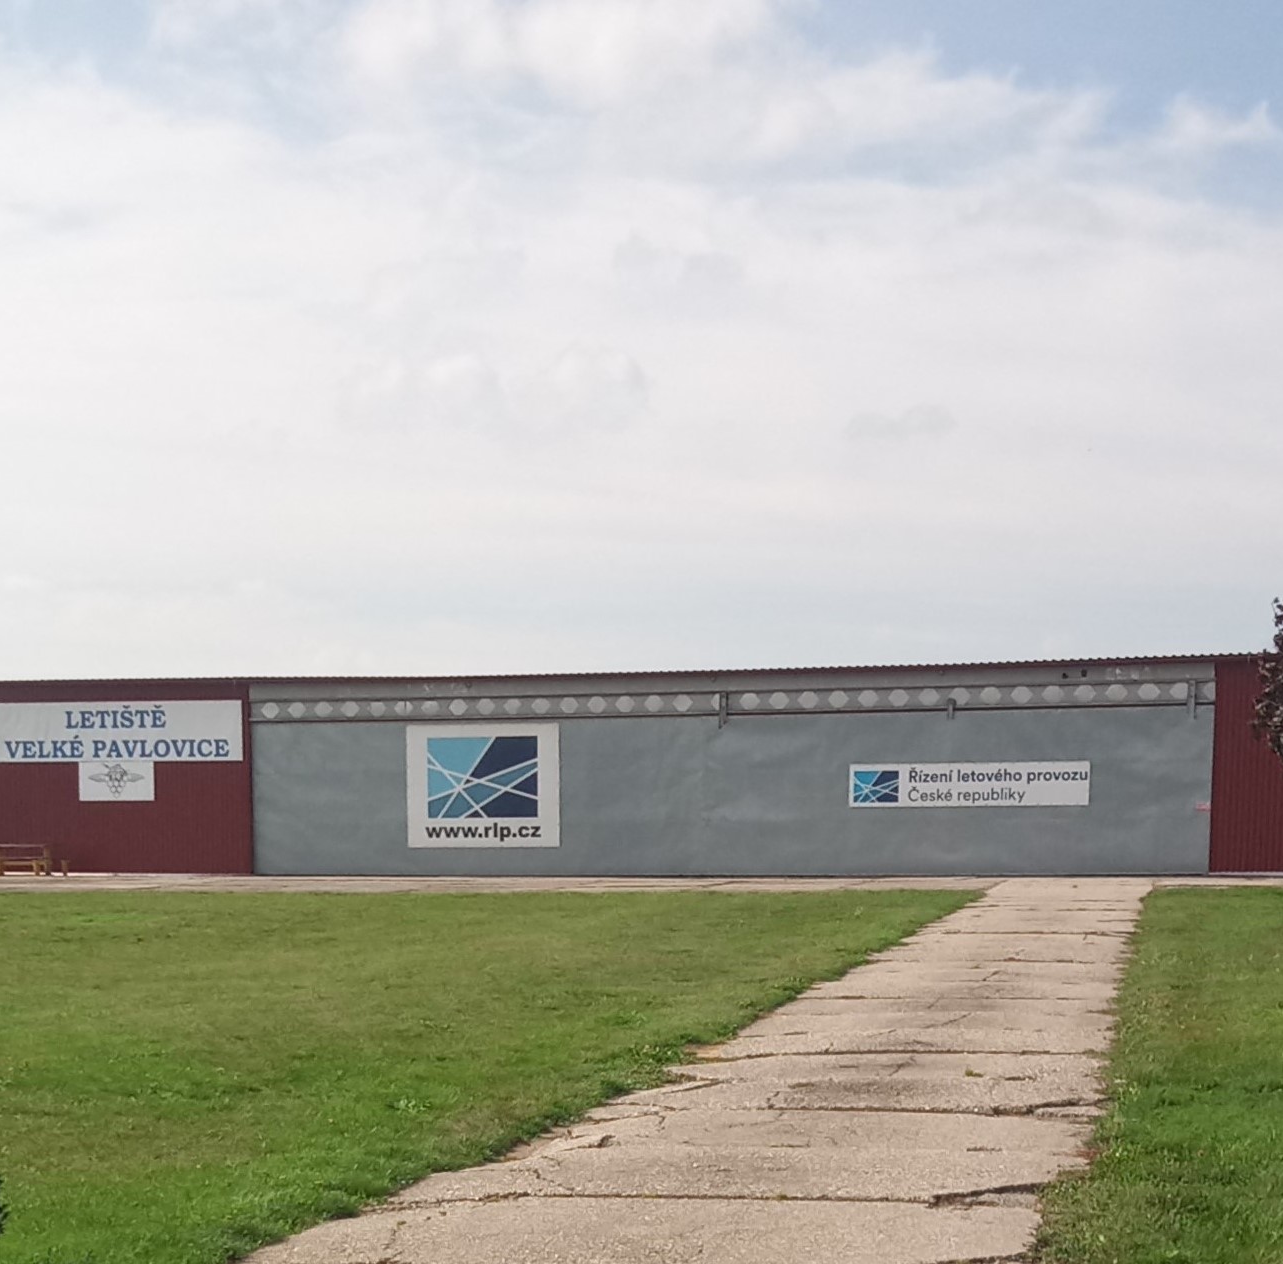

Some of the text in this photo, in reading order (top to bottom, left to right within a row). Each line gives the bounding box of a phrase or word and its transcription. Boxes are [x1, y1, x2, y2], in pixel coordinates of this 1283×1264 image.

[65, 704, 167, 729] LETIŠTĚ
[4, 735, 230, 758] VELKÉ PAVLOVICE
[908, 767, 1088, 784] Řízení letového provozu
[907, 787, 1026, 803] České republiky
[425, 822, 542, 842] www.rlp.cz
